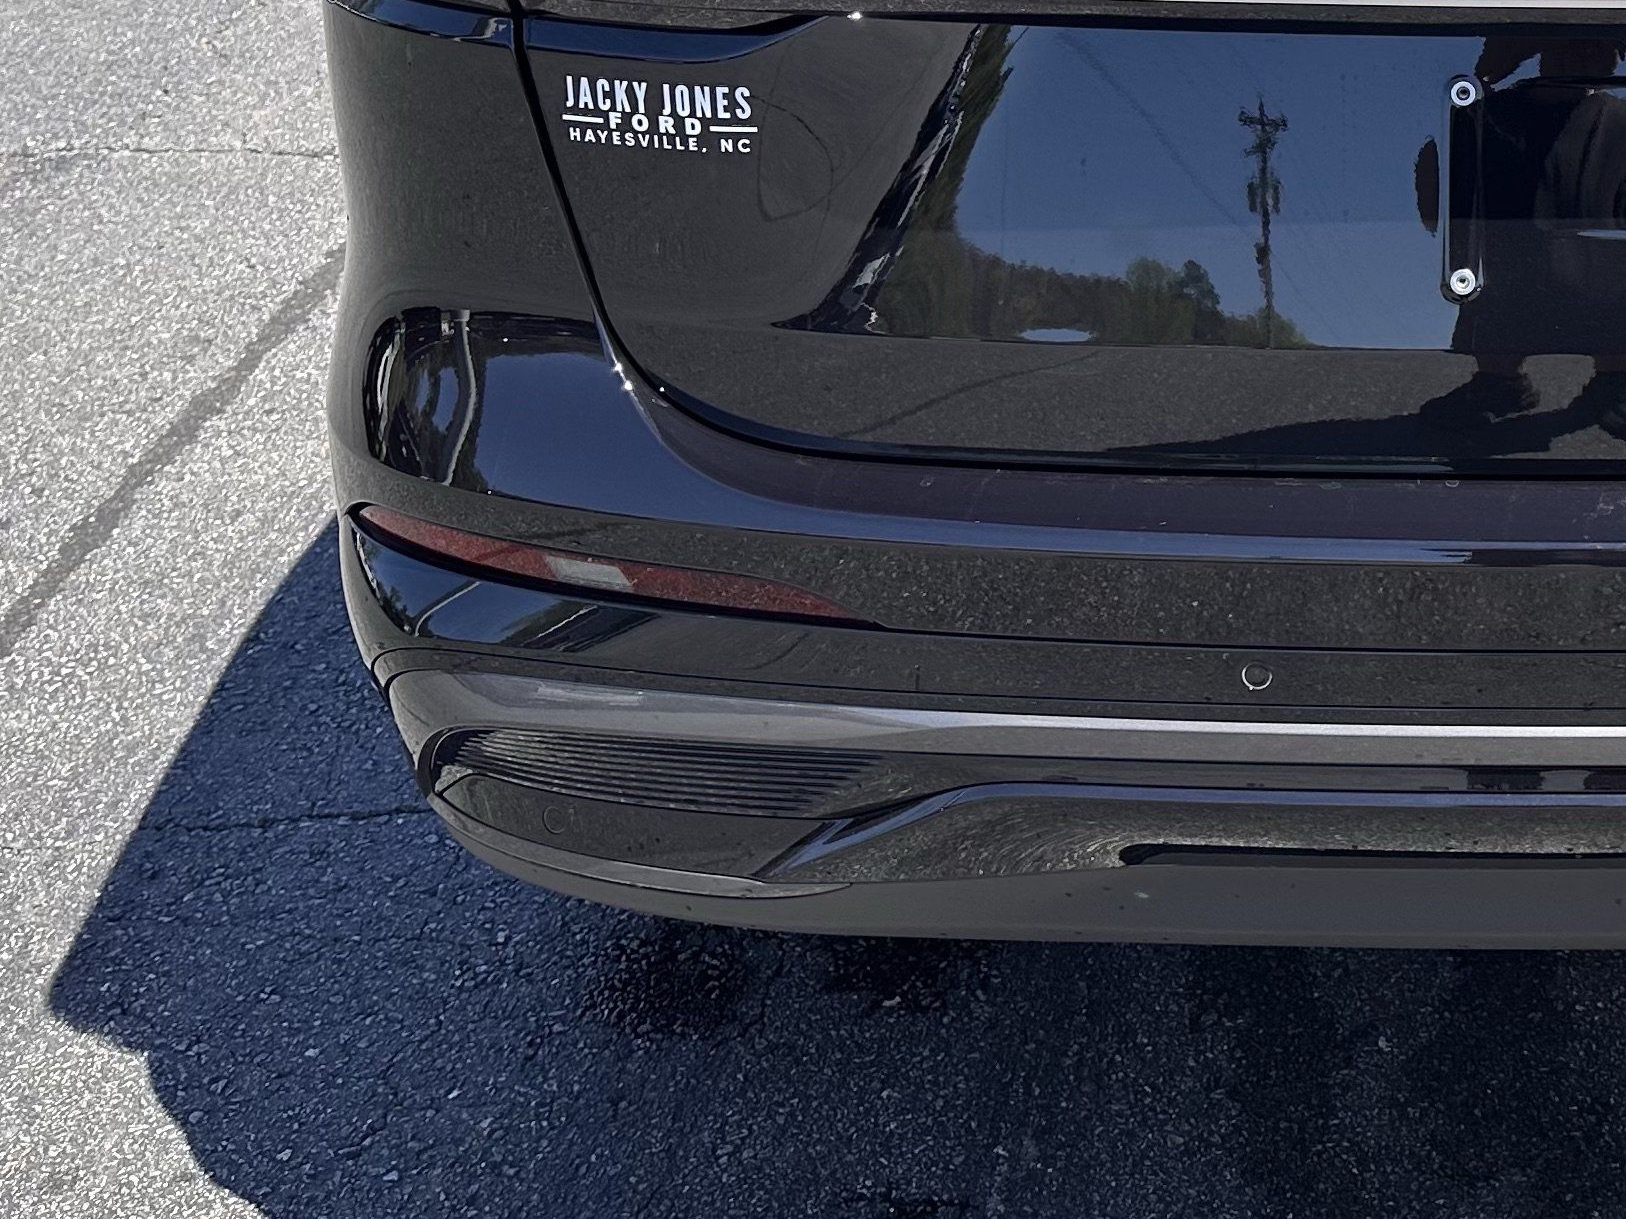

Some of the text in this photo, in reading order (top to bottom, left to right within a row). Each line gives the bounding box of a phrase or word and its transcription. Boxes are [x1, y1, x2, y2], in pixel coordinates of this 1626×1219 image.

[565, 75, 752, 119] JACKY JONES
[608, 112, 702, 136] FORD
[569, 127, 751, 153] HAYESVILLE, NC
